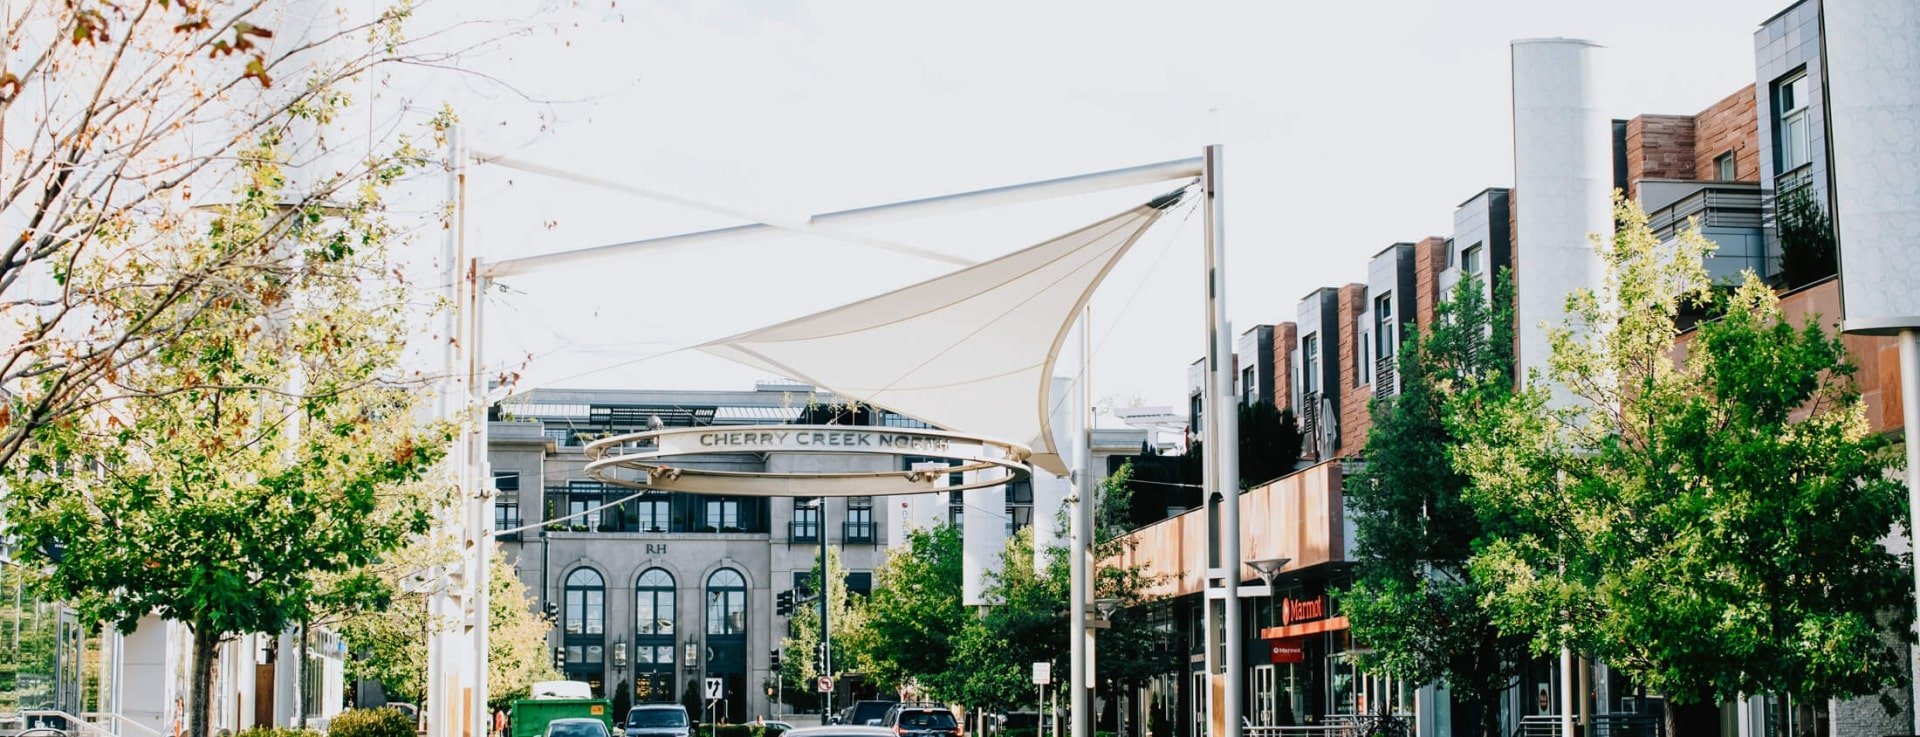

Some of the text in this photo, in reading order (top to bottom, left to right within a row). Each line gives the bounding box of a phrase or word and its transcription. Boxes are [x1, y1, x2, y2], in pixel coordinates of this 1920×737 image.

[700, 432, 950, 451] CHERRY CREEK NORTH
[646, 543, 666, 554] RH
[1291, 595, 1322, 621] Marmot
